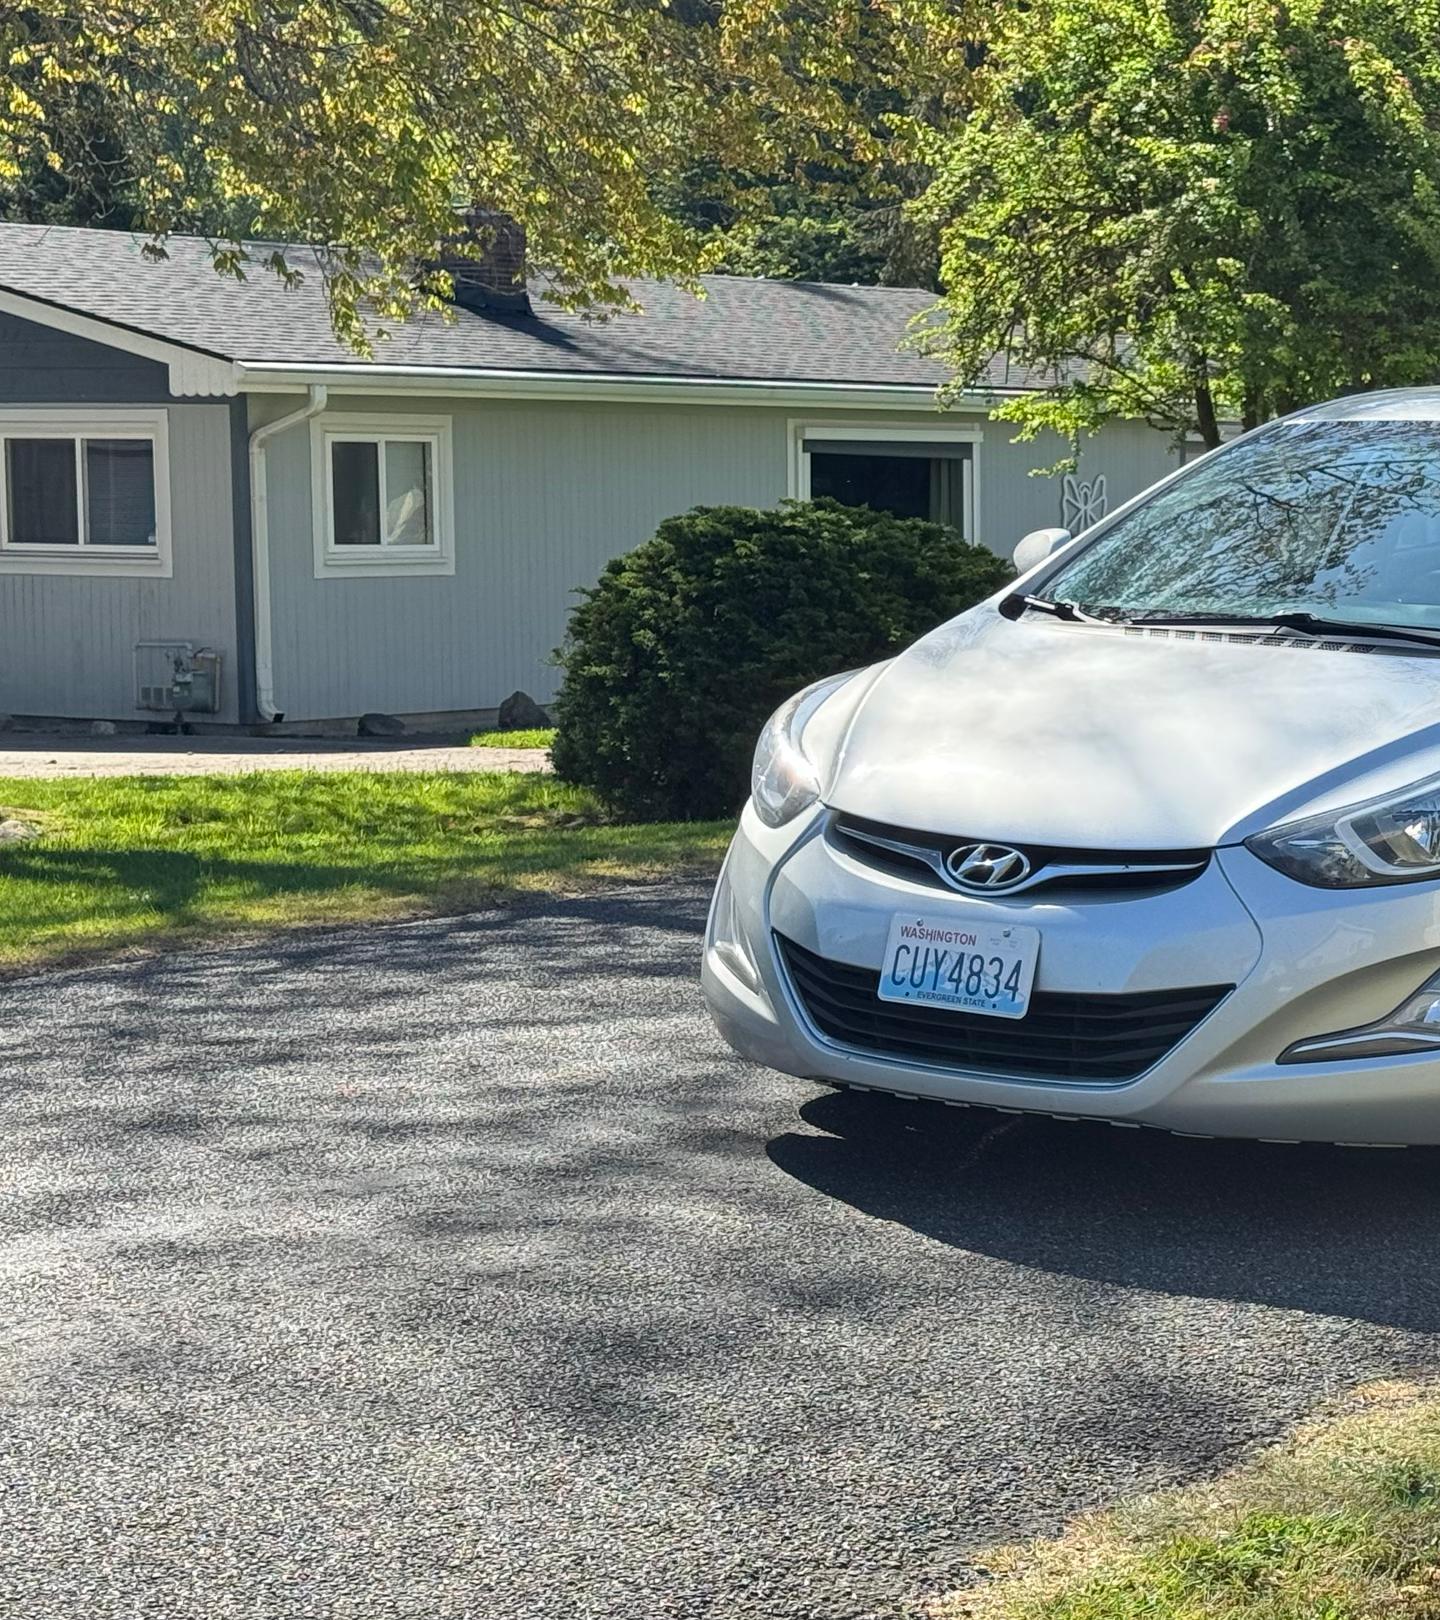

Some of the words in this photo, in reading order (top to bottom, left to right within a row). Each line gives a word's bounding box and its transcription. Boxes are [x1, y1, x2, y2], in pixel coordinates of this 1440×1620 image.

[900, 926, 977, 946] WASHINGTON
[891, 944, 1023, 1002] CUY4834
[916, 991, 961, 1005] EVERGREEN
[962, 995, 986, 1008] STATE
